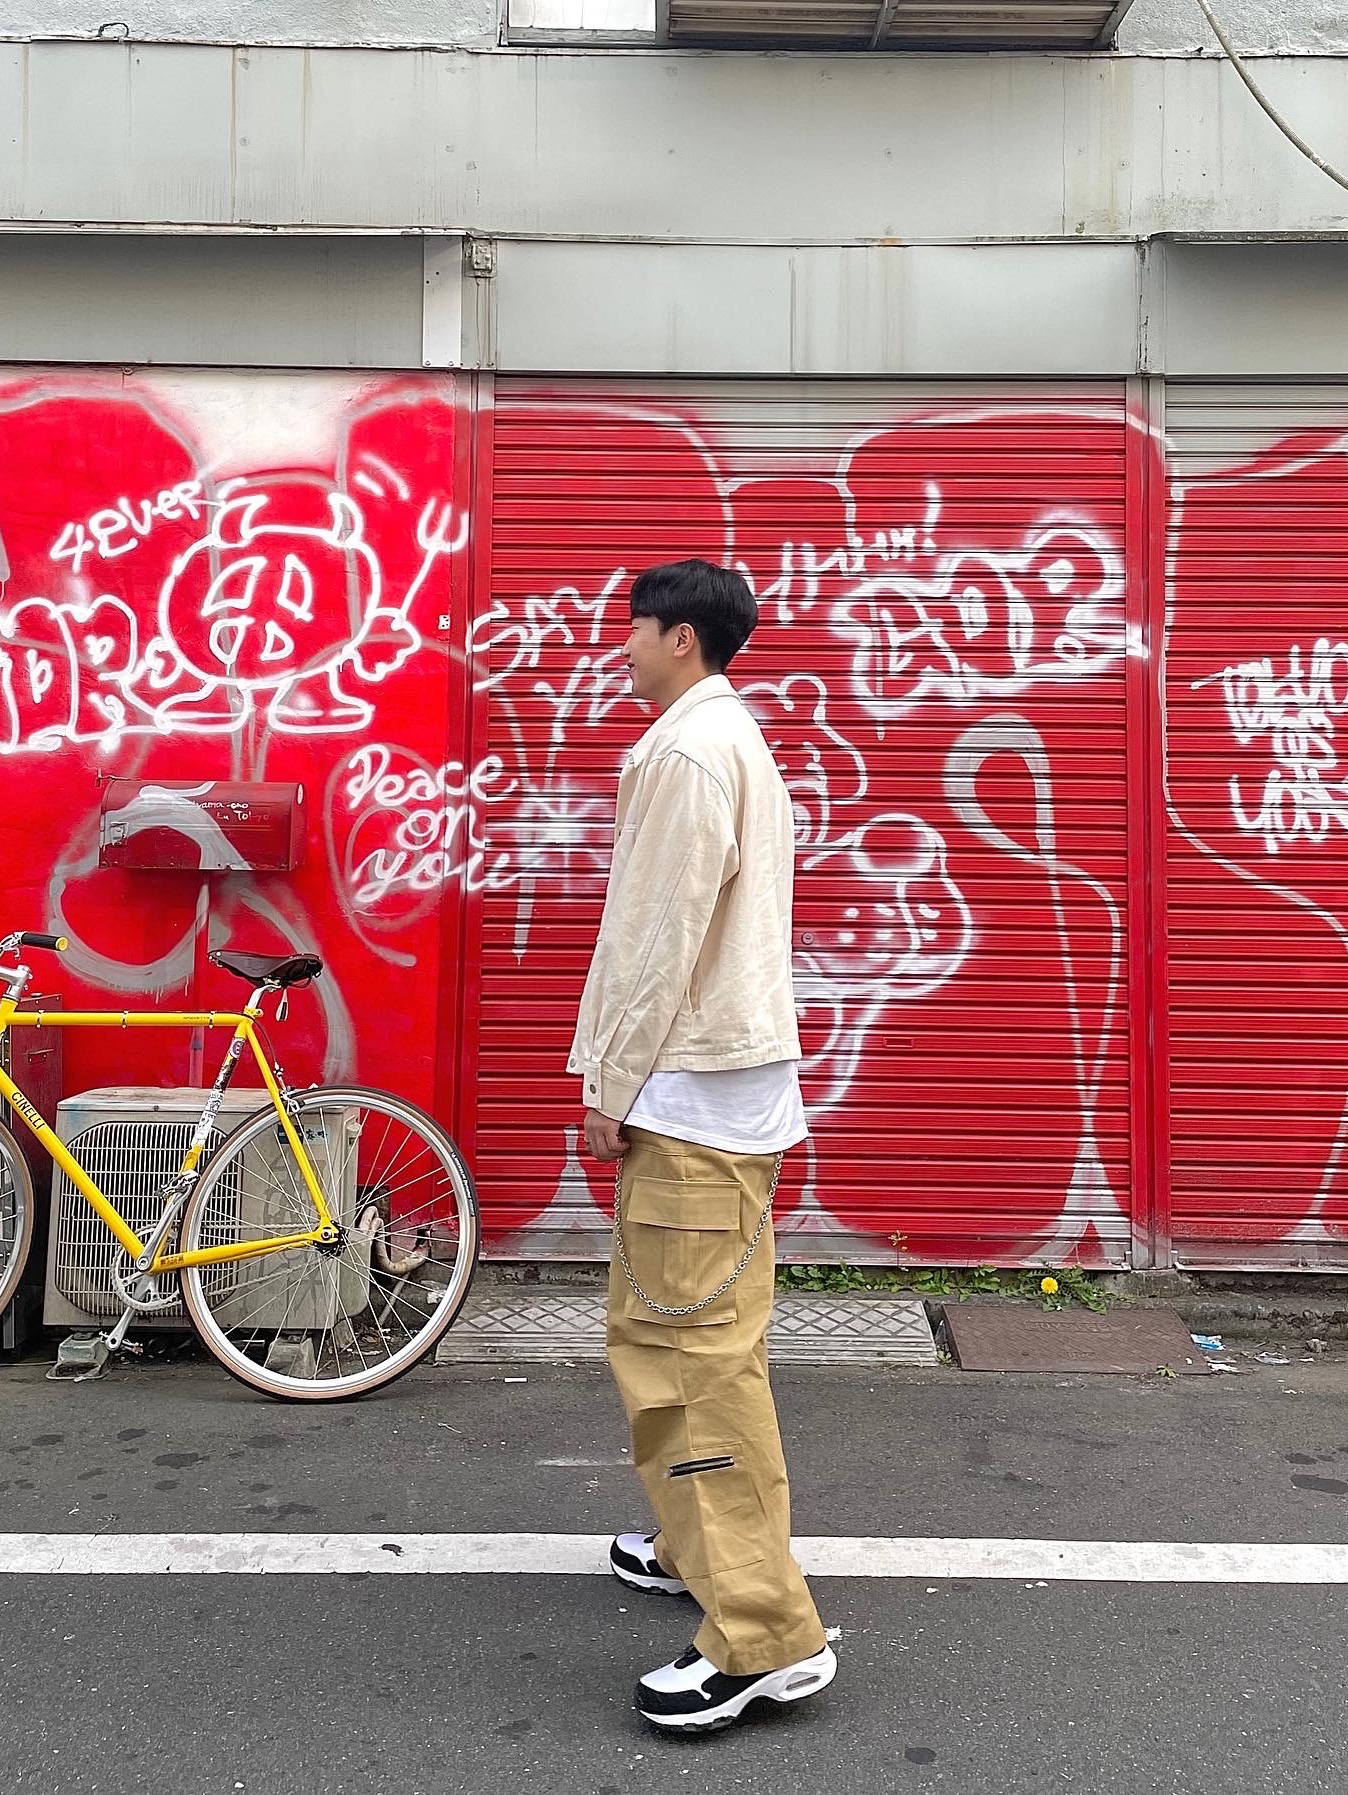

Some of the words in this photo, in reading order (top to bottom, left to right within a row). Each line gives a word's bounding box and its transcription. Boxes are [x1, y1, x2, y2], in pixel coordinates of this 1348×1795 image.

[347, 743, 519, 808] Peace
[396, 804, 492, 850] on
[352, 849, 518, 902] you
[12, 1092, 45, 1130] CINELLI
